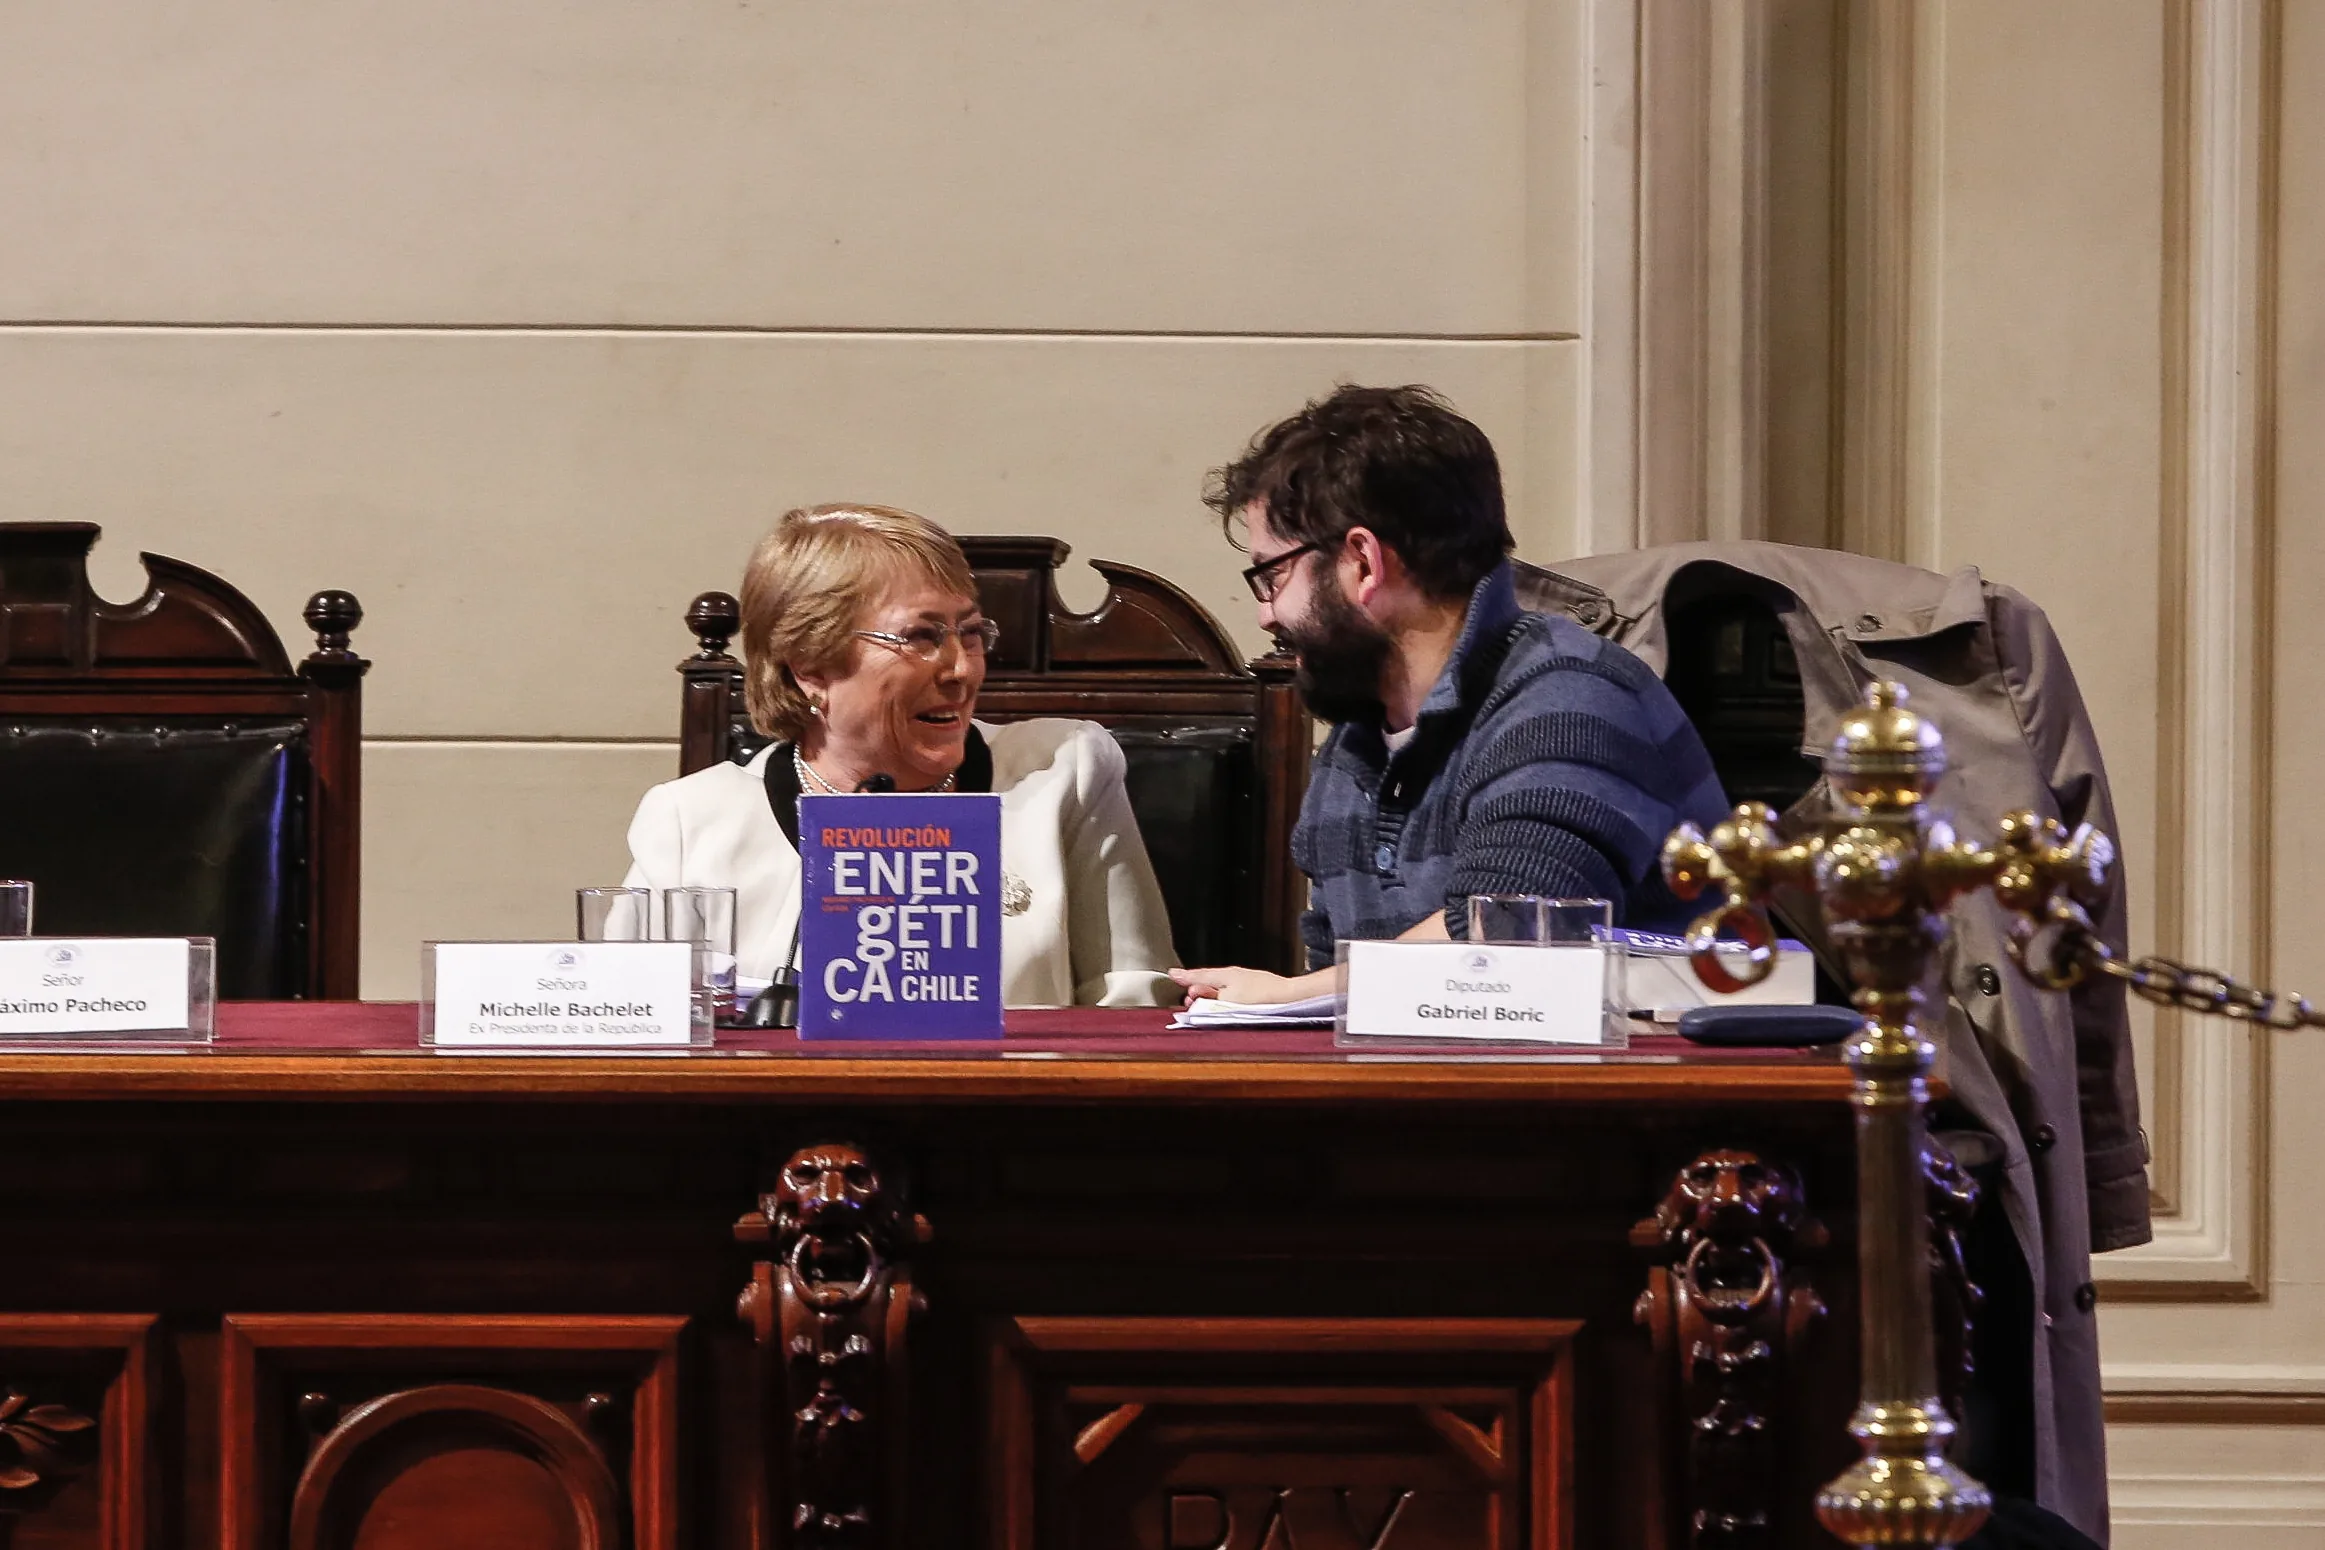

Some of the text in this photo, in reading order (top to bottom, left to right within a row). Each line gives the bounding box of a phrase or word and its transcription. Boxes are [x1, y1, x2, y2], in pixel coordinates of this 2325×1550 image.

[822, 824, 951, 847] REVOLUCIÓN
[834, 851, 980, 895] ENER
[901, 951, 930, 972] EN
[42, 974, 84, 987] Señor
[536, 978, 588, 991] Señora
[823, 957, 896, 1003] CA
[901, 975, 980, 1002] CHILE
[1445, 979, 1511, 993] Diputado
[0, 998, 147, 1014] áximo Pacheco
[479, 1002, 654, 1017] Michelle Bachelet
[1417, 1003, 1545, 1023] Gabriel Boric
[469, 1022, 662, 1036] Ex Presidenta de la República
